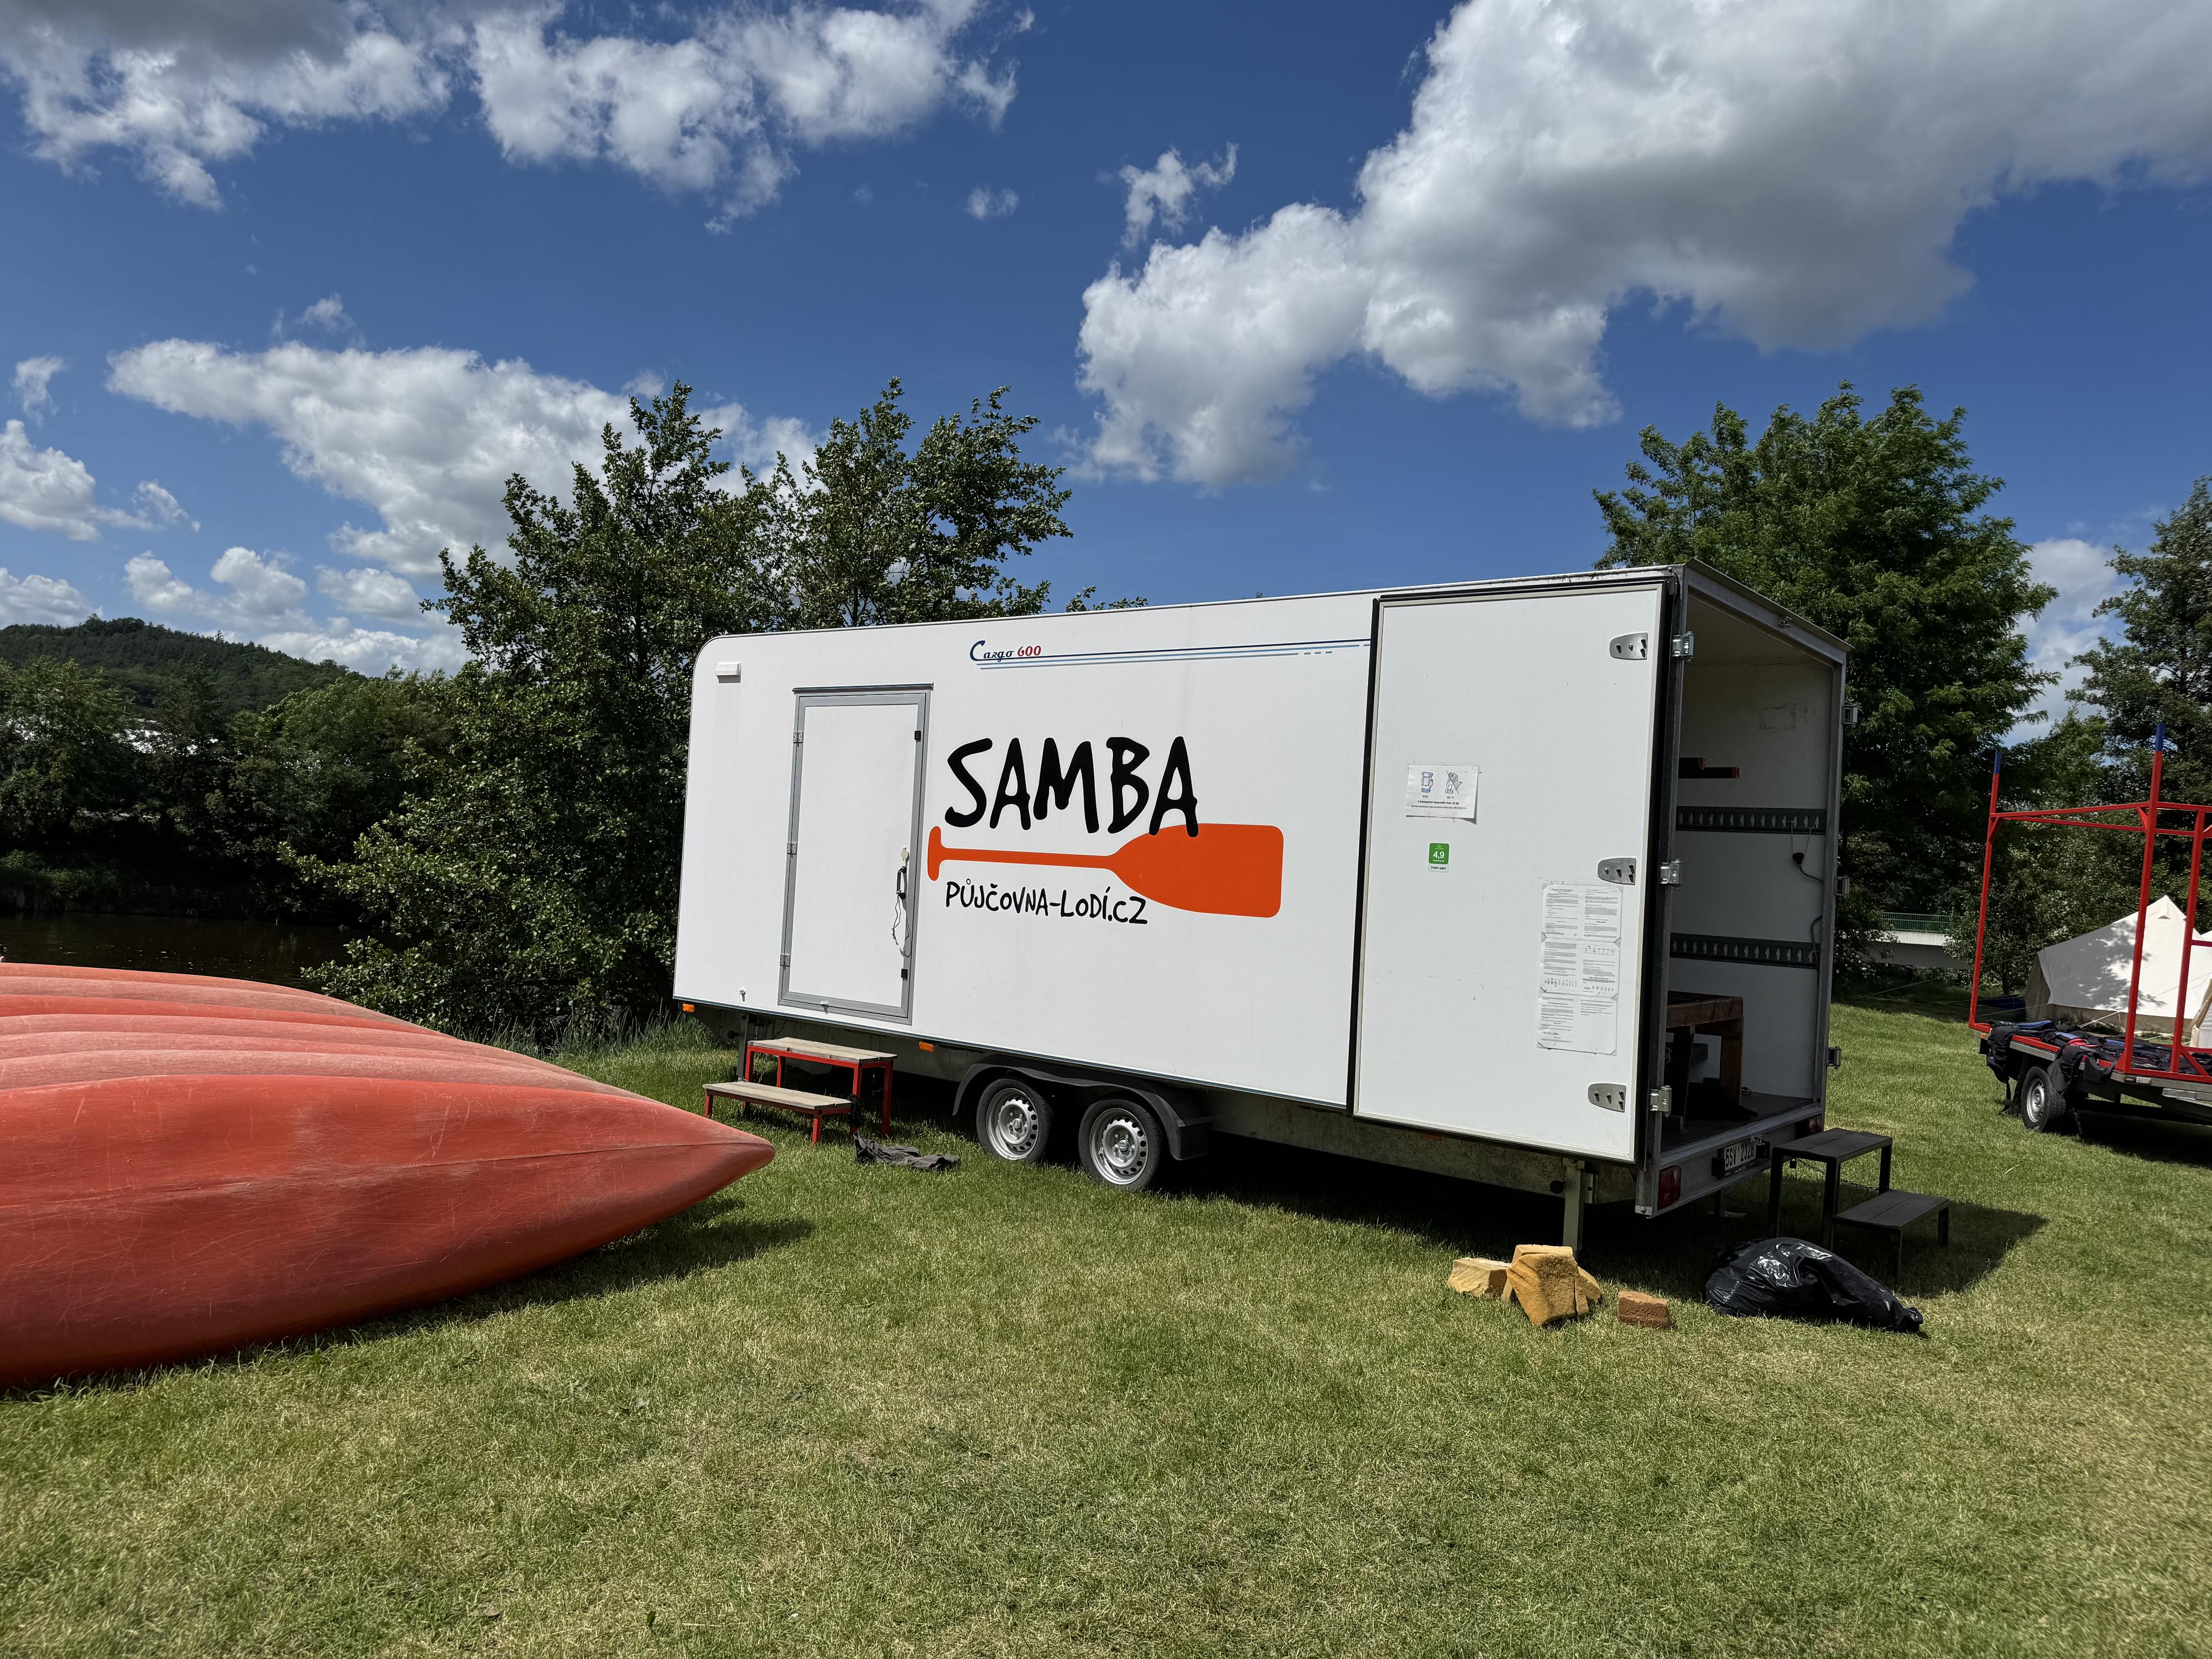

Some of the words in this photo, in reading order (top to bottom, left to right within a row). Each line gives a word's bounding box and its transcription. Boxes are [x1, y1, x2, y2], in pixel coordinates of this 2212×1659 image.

[969, 640, 1014, 662] Cargo
[1018, 645, 1041, 657] 600
[945, 736, 1199, 838] SAMBA
[1433, 851, 1444, 860] 4,9
[946, 878, 1148, 925] PŮJČOVNA-LODÍ.CZ
[1725, 1145, 1737, 1167] 5SV
[1740, 1141, 1754, 1162] 2328
